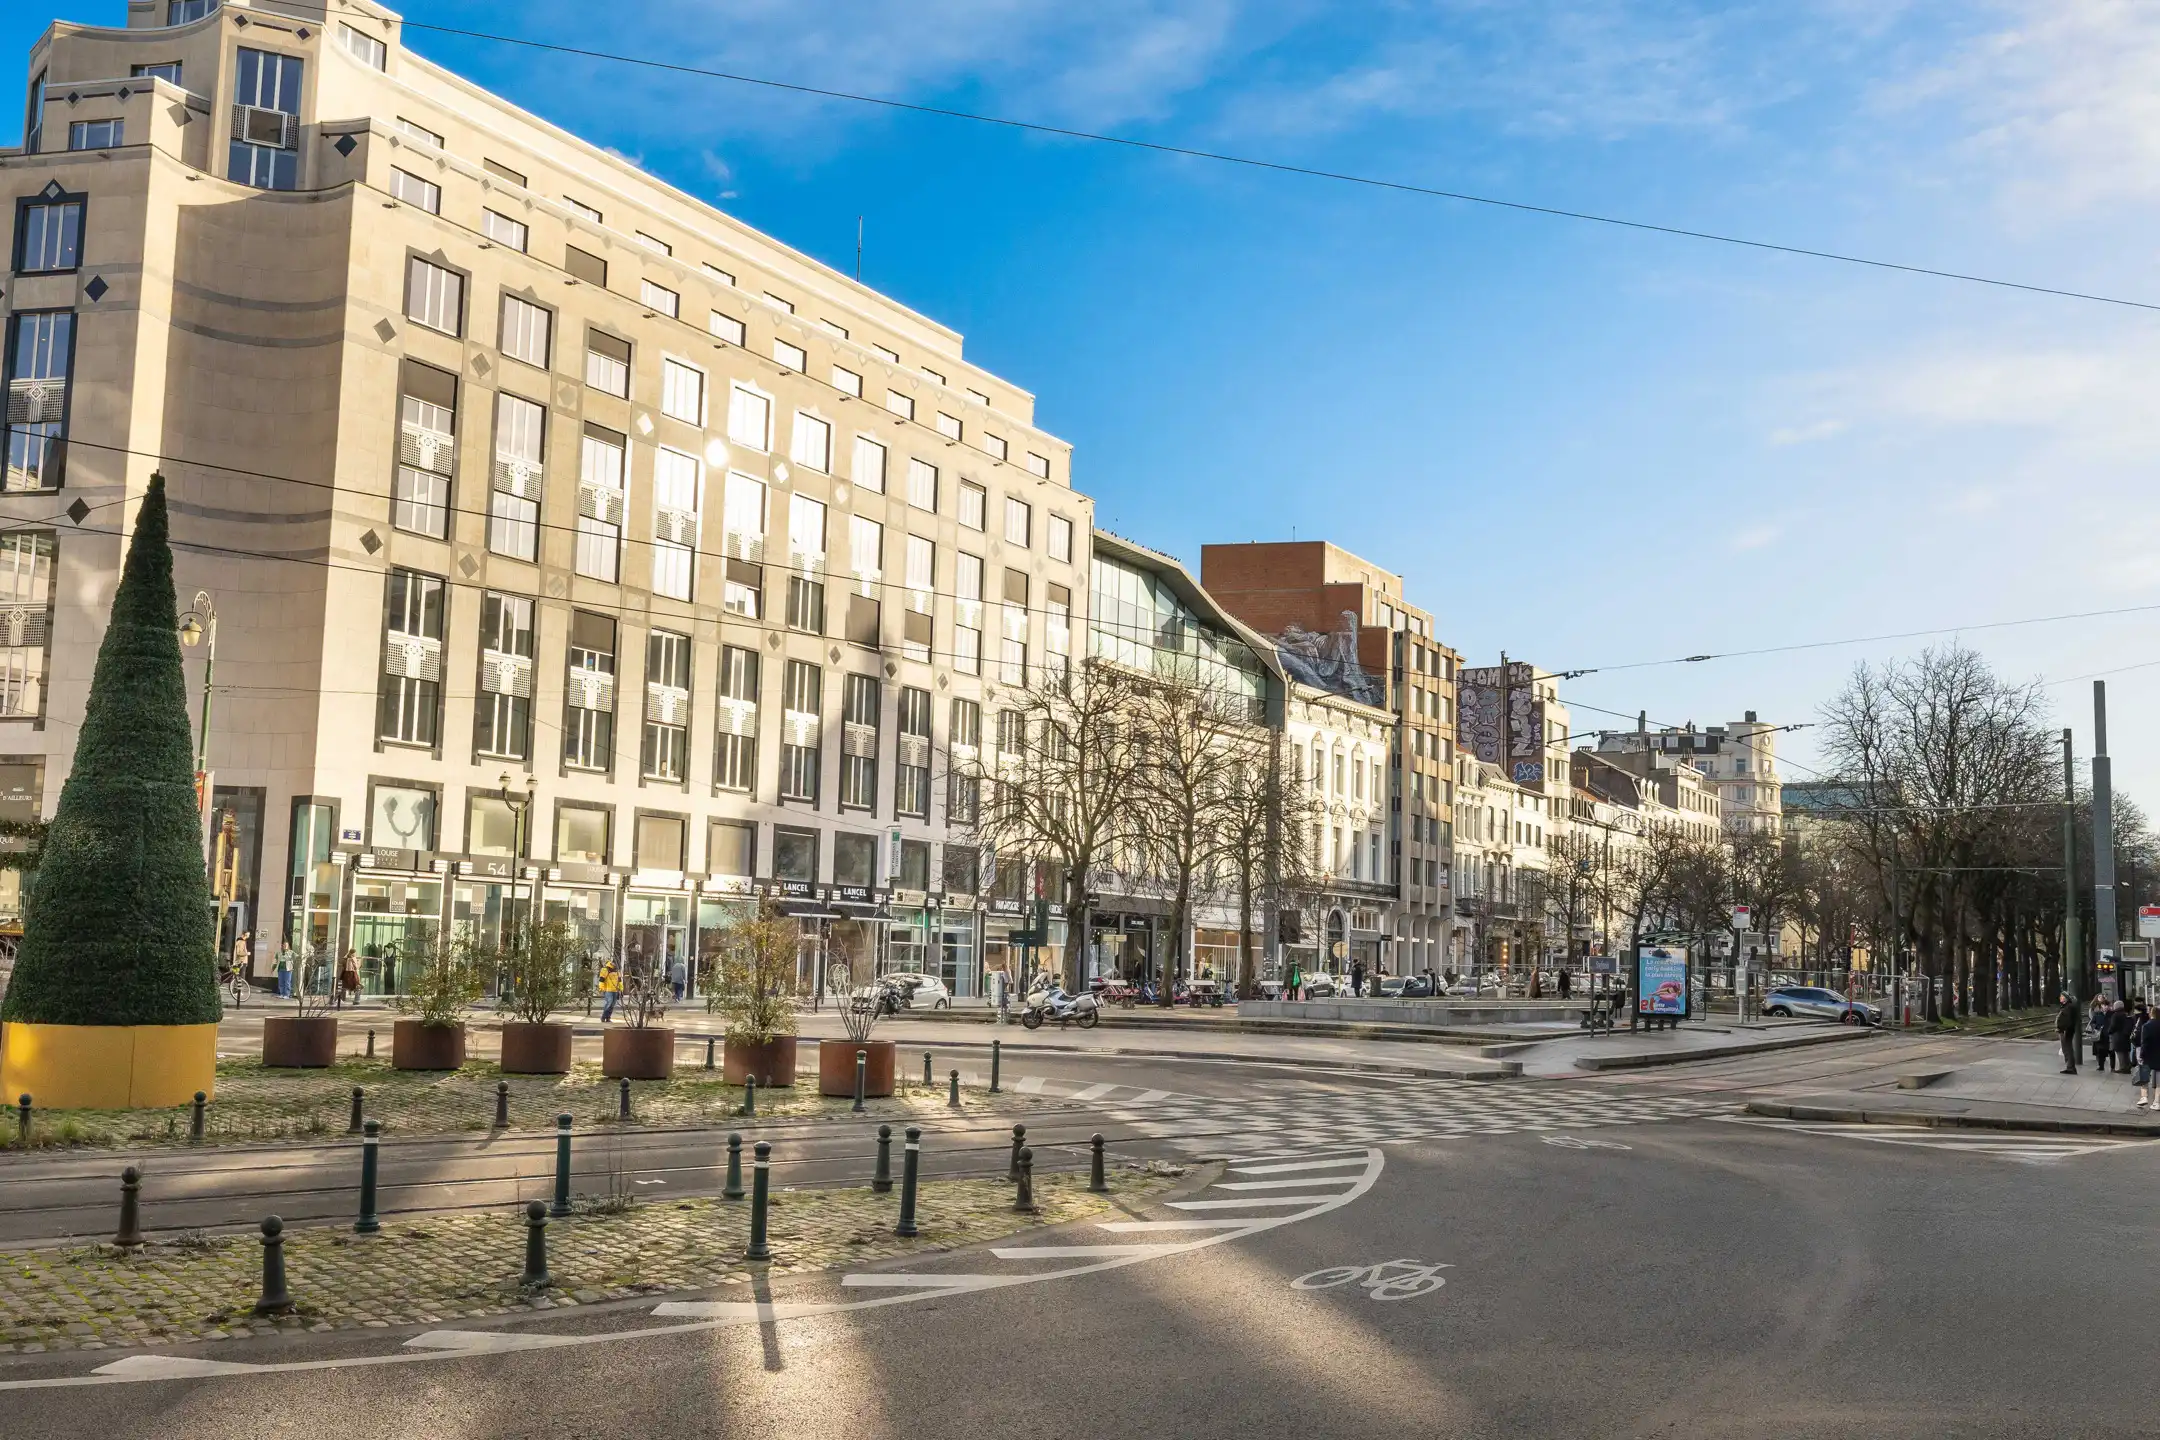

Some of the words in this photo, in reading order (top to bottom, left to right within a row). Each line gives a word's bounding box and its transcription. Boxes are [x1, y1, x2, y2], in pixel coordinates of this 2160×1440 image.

[377, 849, 399, 857] LOUISE
[487, 862, 507, 876] 54
[784, 883, 808, 892] LANCEL
[844, 888, 866, 896] LANCEL
